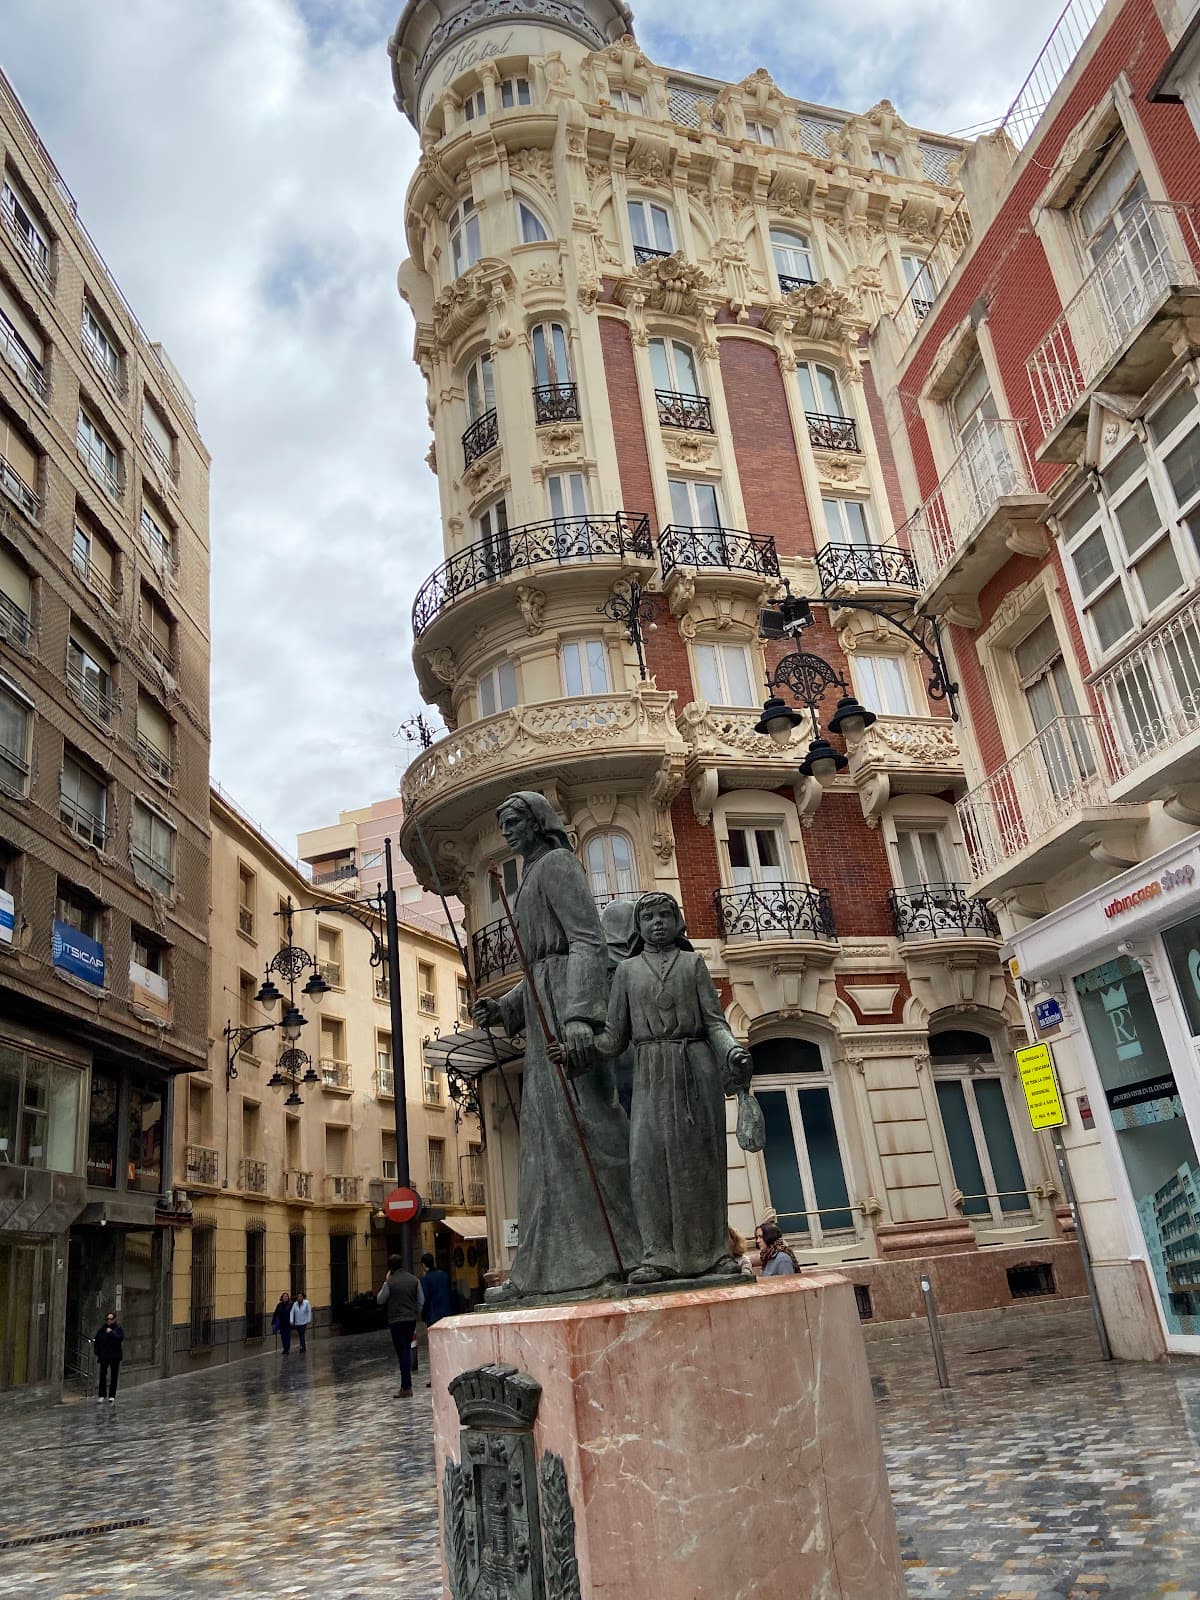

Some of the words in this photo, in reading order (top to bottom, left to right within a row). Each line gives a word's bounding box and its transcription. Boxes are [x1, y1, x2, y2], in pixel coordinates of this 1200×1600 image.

[442, 32, 514, 86] Hotel
[1104, 881, 1162, 918] urbincasa
[1160, 865, 1195, 891] shop
[62, 943, 104, 968] ITSICAP
